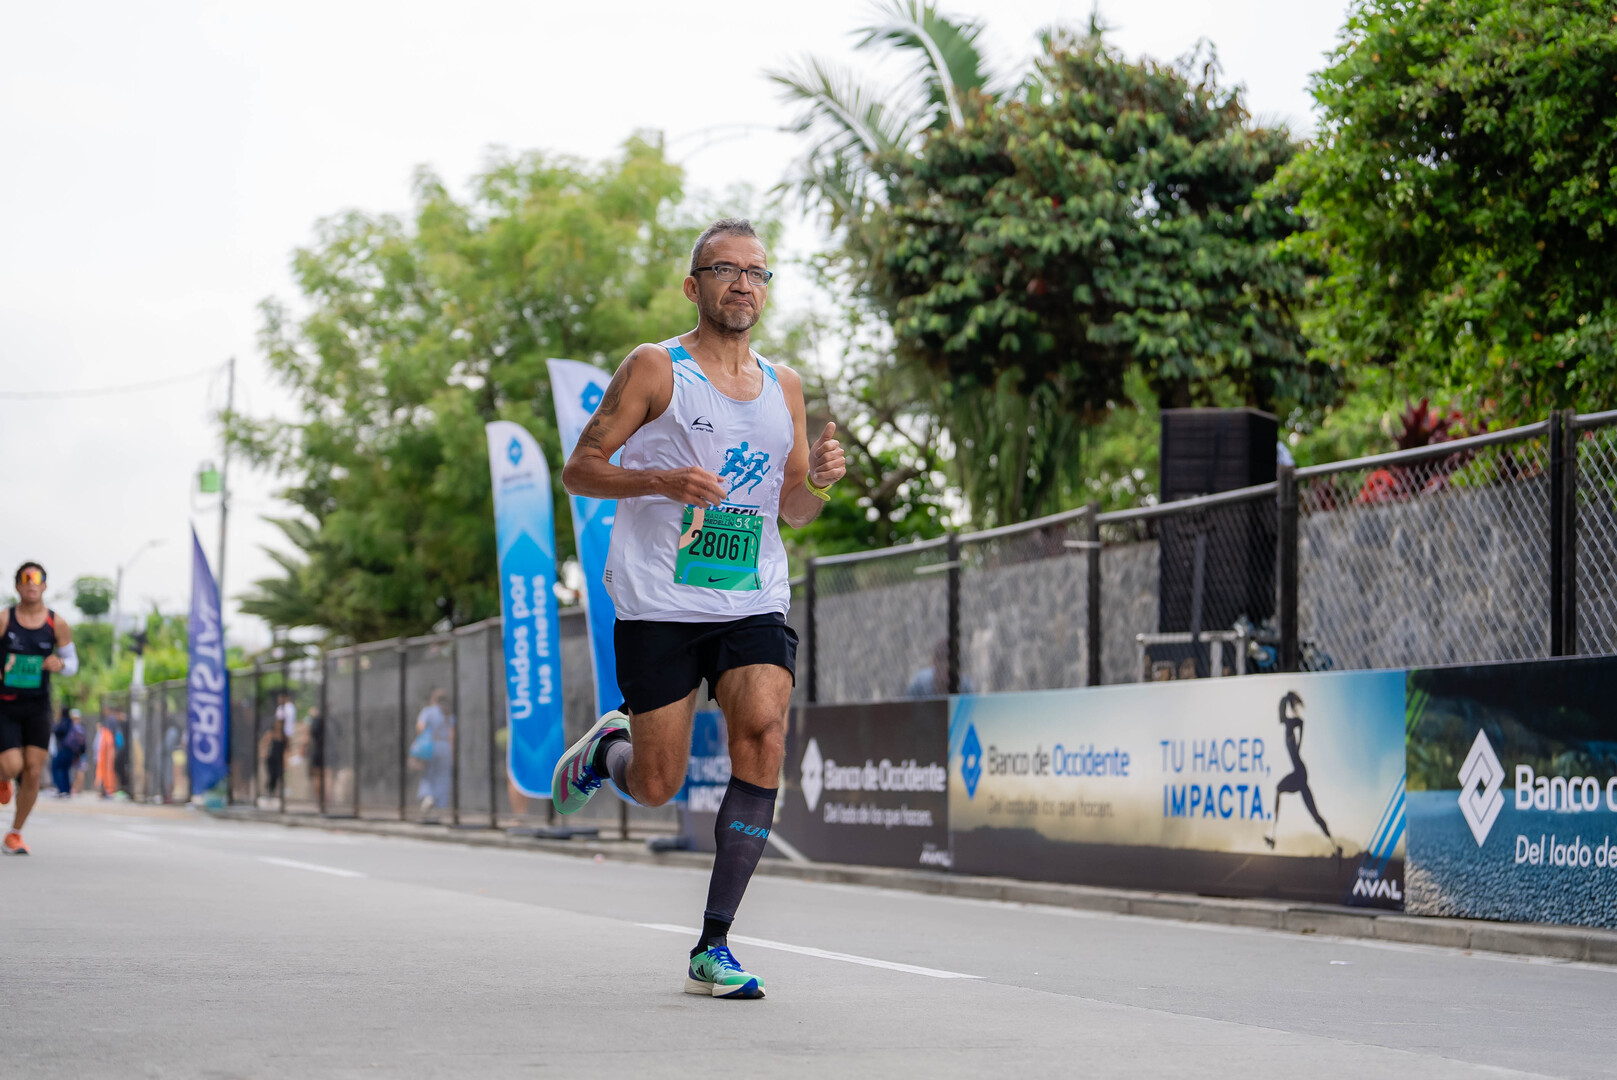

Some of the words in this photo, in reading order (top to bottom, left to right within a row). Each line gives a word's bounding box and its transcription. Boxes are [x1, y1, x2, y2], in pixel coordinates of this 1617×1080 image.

[688, 529, 750, 562] 28061
[510, 573, 531, 619] por
[532, 574, 550, 657] metas
[510, 624, 534, 720] Unidos
[538, 664, 552, 704] tus
[824, 759, 861, 790] Banco
[862, 759, 879, 791] de
[879, 759, 946, 792] Occidente
[987, 745, 1030, 776] Banco
[1032, 744, 1049, 776] de
[1052, 743, 1130, 777] Occidente
[1160, 741, 1185, 773] TU
[1192, 738, 1271, 777] HACER,
[1163, 784, 1271, 820] IMPACTA.
[1515, 764, 1600, 812] Banco
[729, 820, 770, 840] RUN
[1515, 833, 1545, 865] Del
[1549, 833, 1592, 868] lado
[1595, 835, 1617, 869] de
[1352, 878, 1402, 900] AVAL
